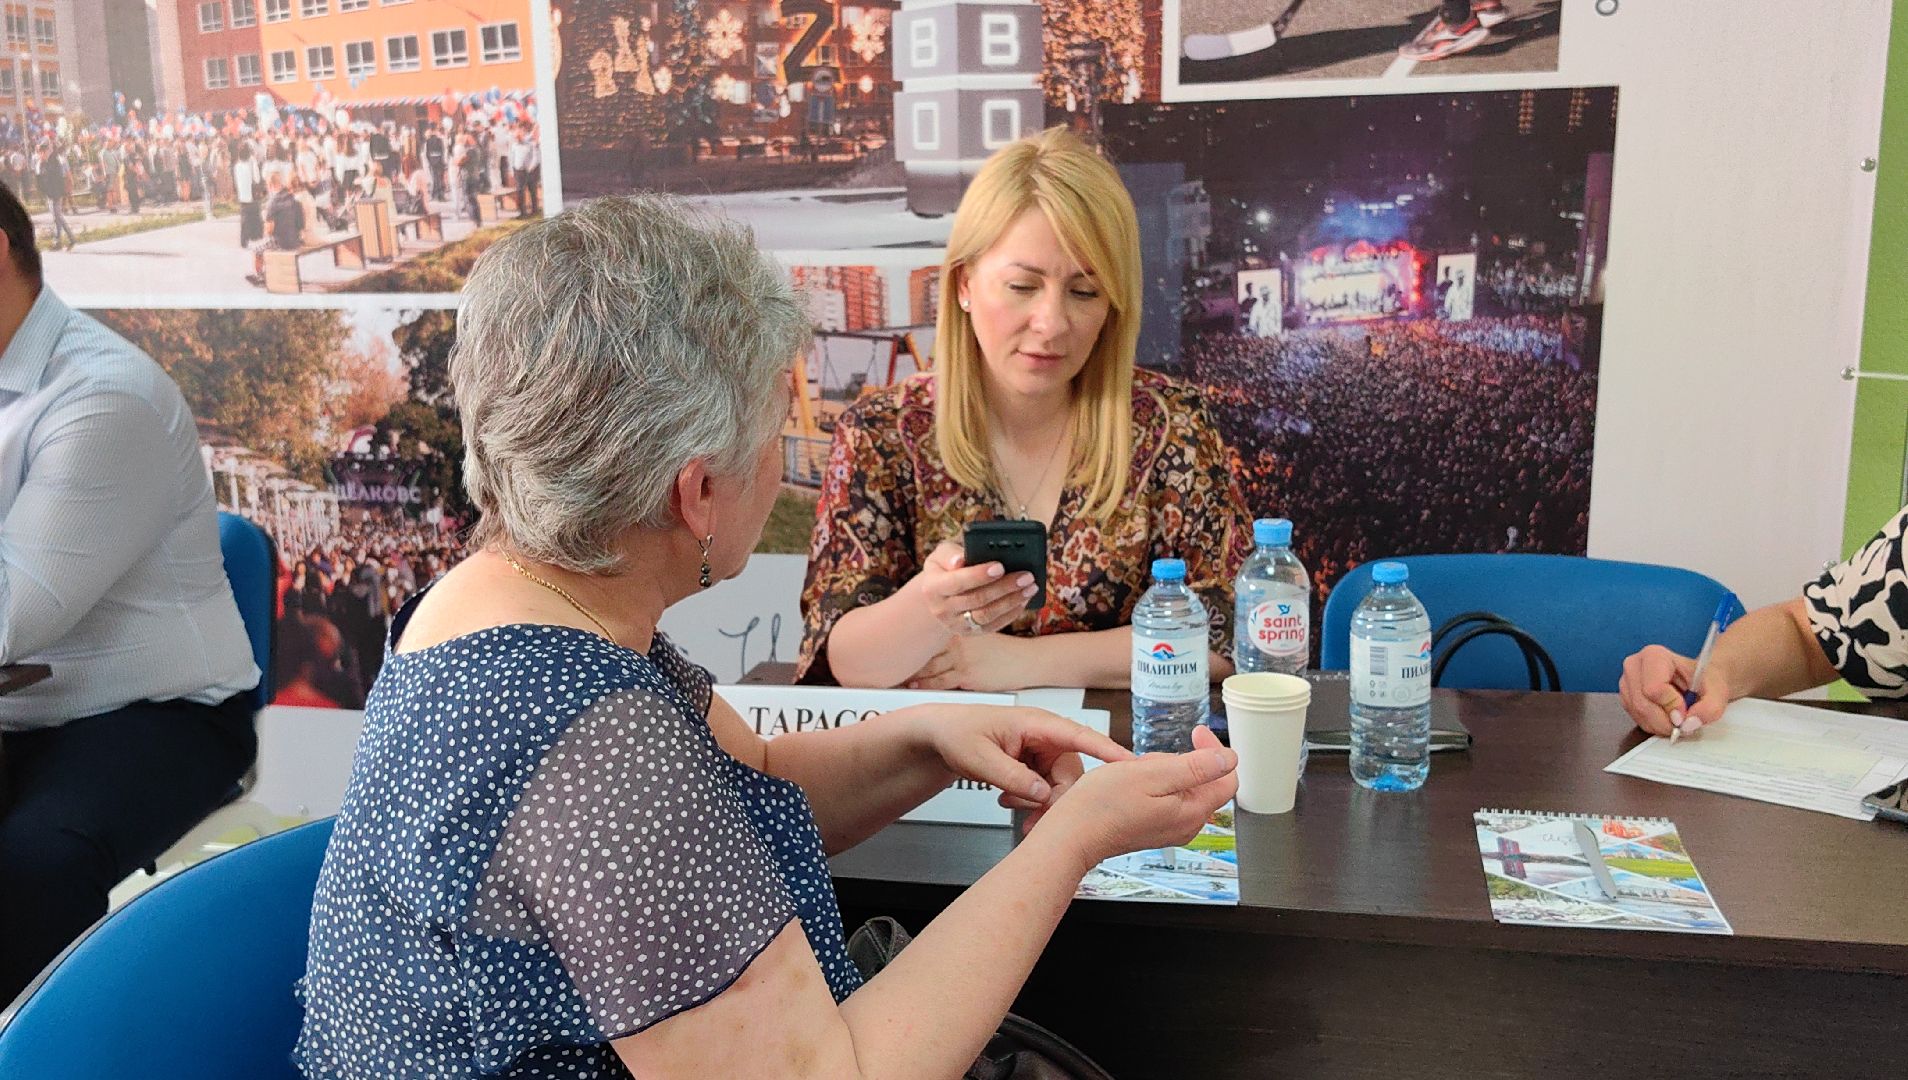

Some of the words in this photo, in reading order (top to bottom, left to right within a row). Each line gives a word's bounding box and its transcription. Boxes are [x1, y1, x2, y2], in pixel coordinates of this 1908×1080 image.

[1264, 614, 1302, 628] saint
[1258, 628, 1305, 644] spring
[1137, 660, 1197, 675] ПИЛИГРИМ
[748, 705, 890, 736] ТАРАС
